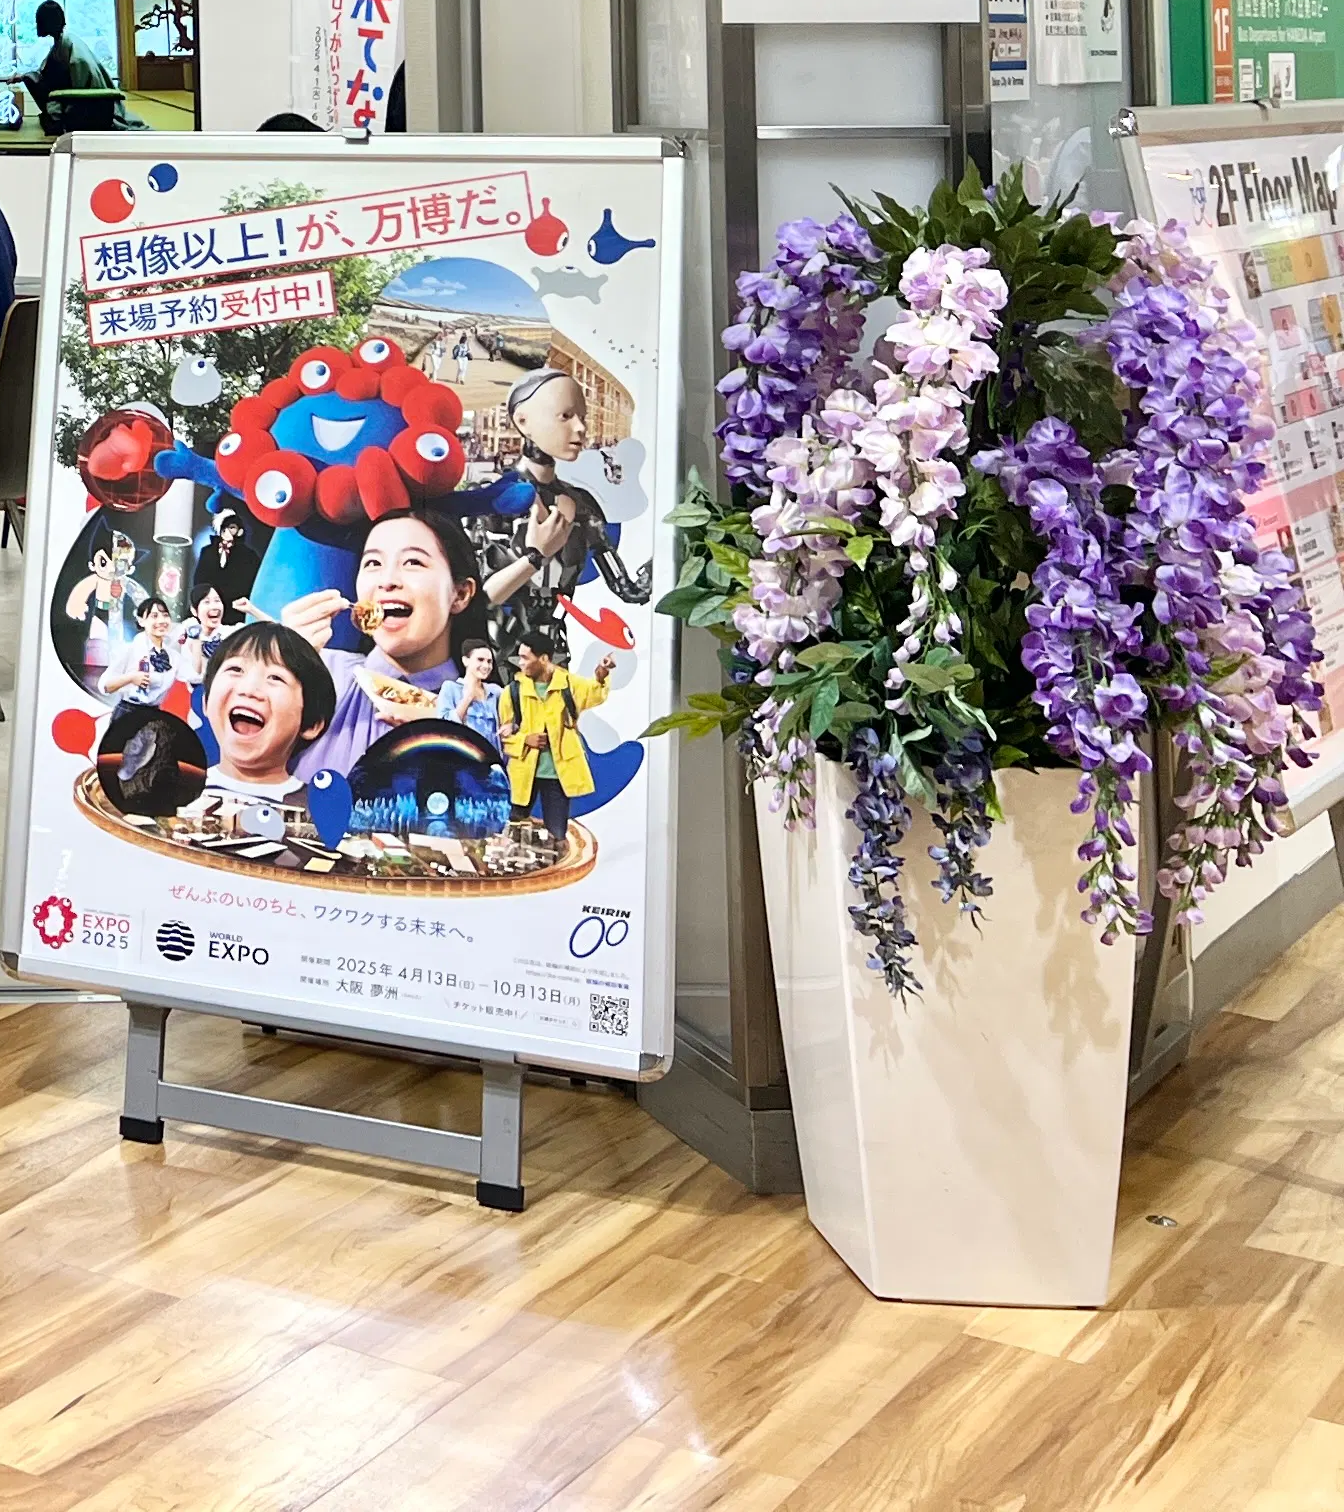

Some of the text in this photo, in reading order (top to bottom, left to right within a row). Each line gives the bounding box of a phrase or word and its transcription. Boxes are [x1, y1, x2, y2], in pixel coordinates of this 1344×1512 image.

[1214, 7, 1230, 52] 1F
[1209, 163, 1238, 227] 2F
[97, 275, 327, 338] 来場予約受付中!
[168, 884, 475, 944] ぜんぶのいのちと、ワクワクする未来へ。
[581, 904, 631, 919] KEIRIN
[82, 913, 131, 935] EXPO
[81, 930, 129, 950] 2025
[208, 930, 244, 943] WORLD
[208, 940, 270, 966] EXPO
[336, 956, 393, 977] 2025年
[335, 978, 364, 996] 大阪
[370, 983, 398, 1001] 夢洲
